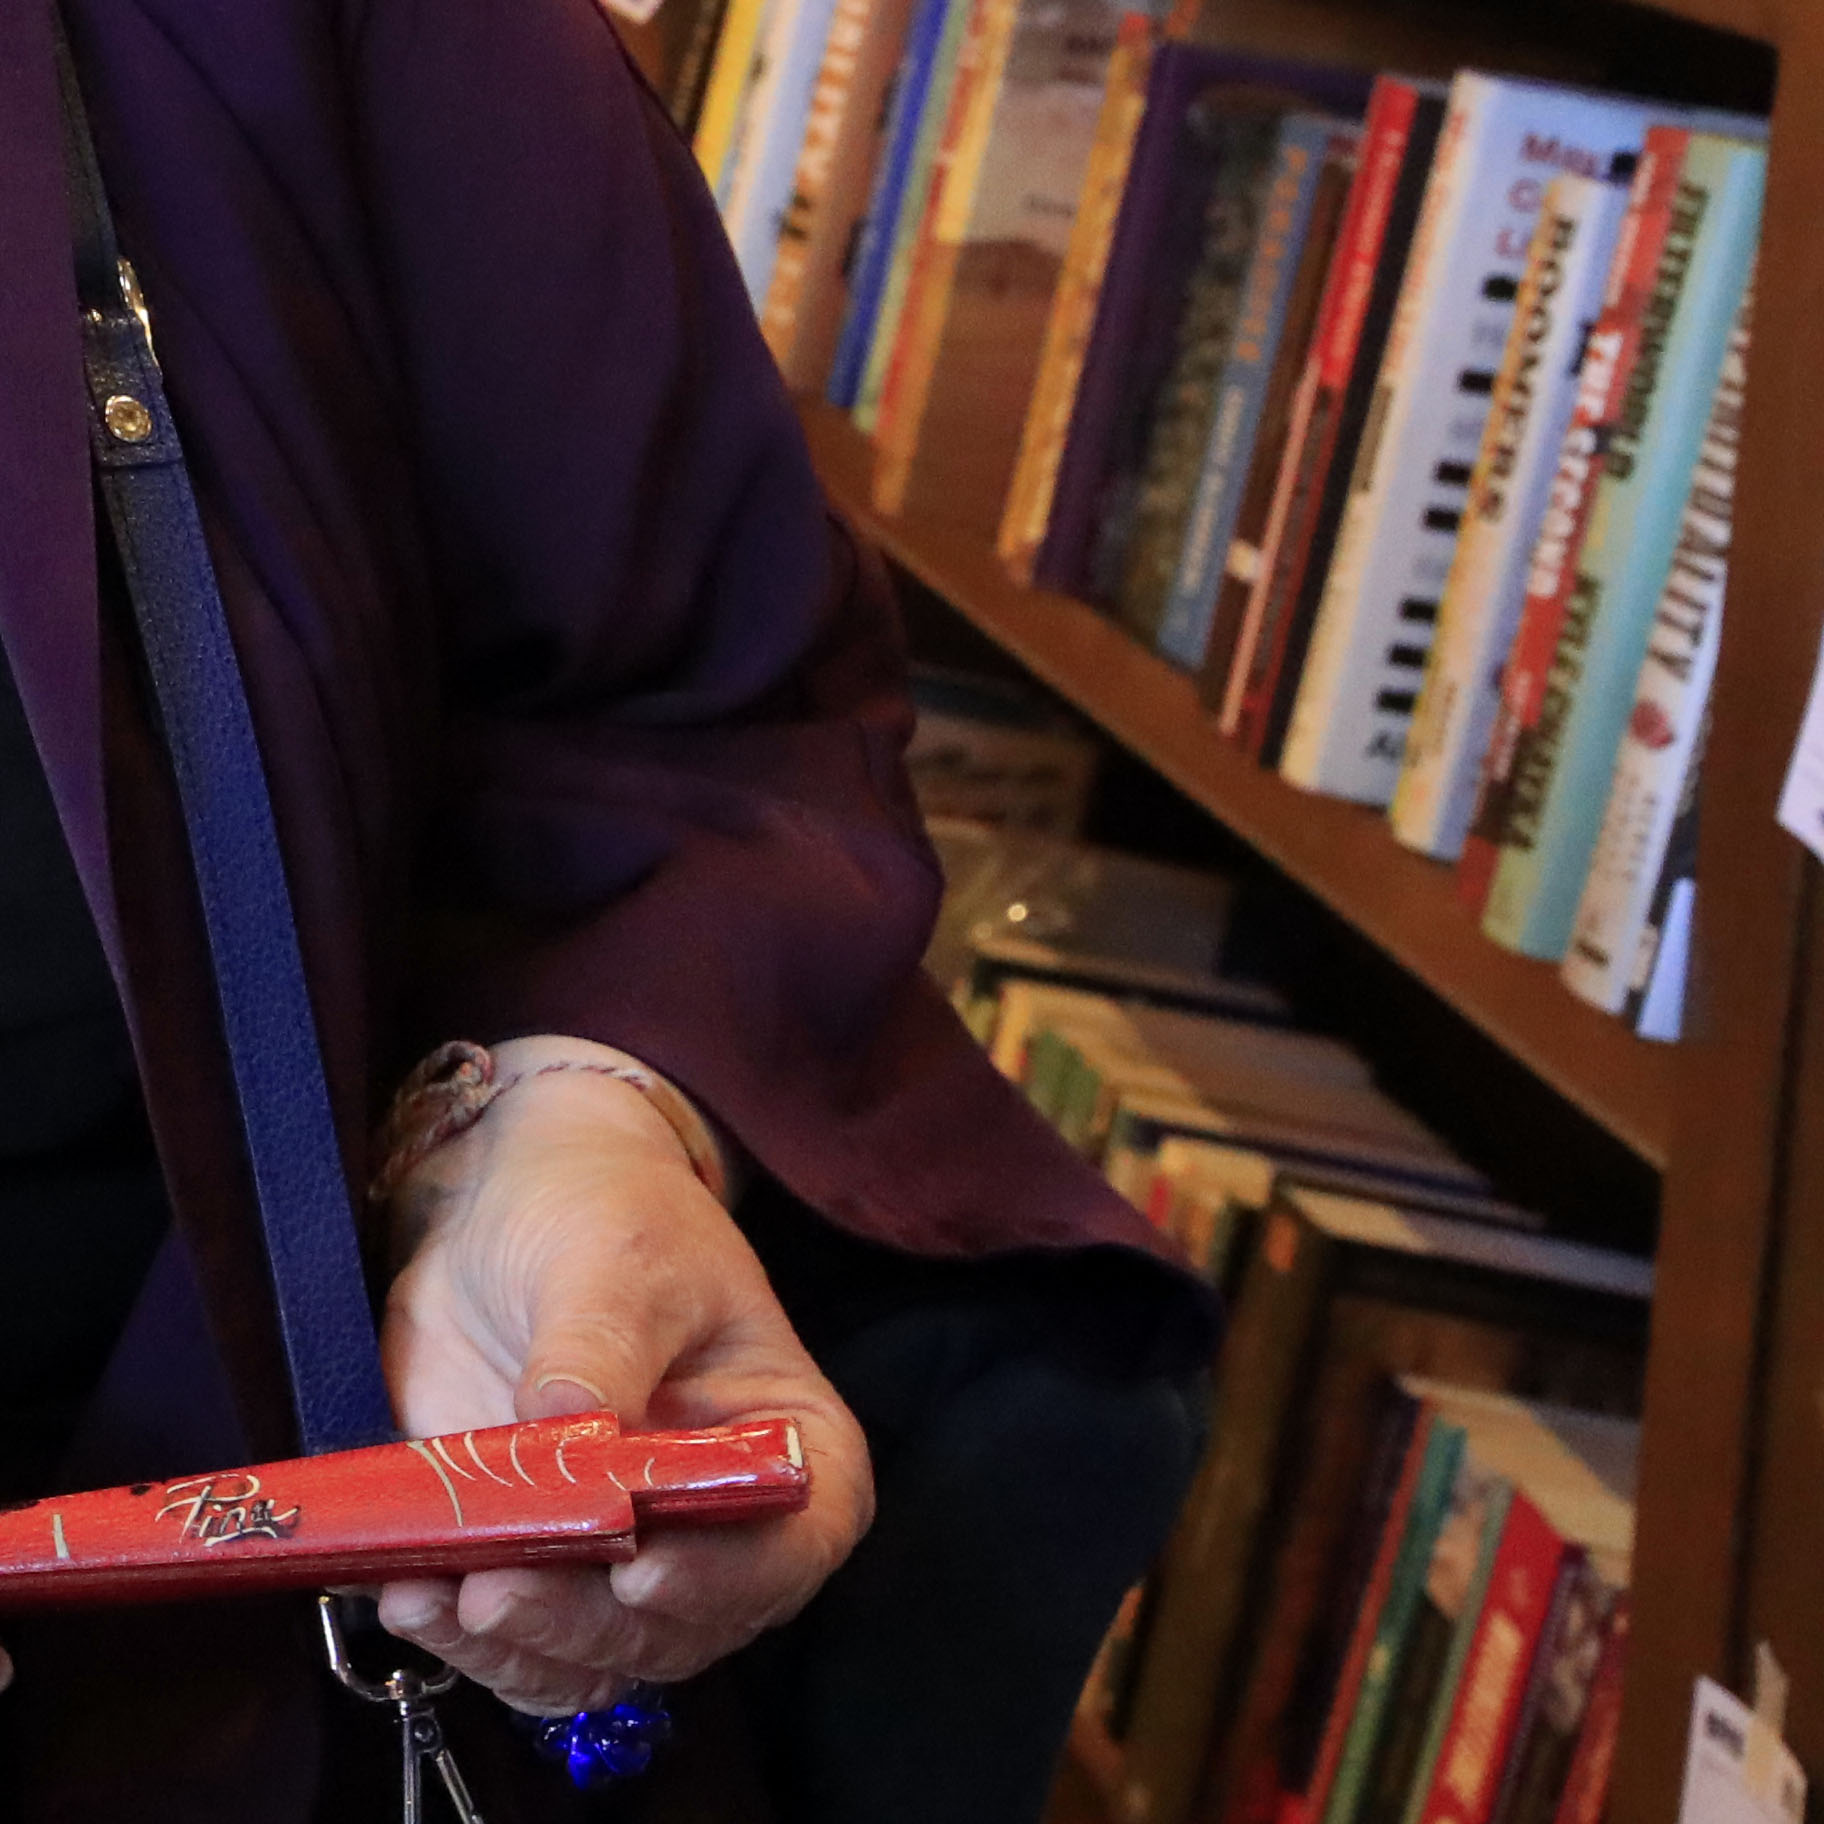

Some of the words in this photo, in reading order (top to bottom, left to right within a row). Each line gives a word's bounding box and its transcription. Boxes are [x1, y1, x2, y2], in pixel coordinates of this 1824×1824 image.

[1462, 208, 1589, 529] BOOMERS
[1596, 181, 1715, 486] FILTERWORLD
[1521, 423, 1602, 603] SECOND
